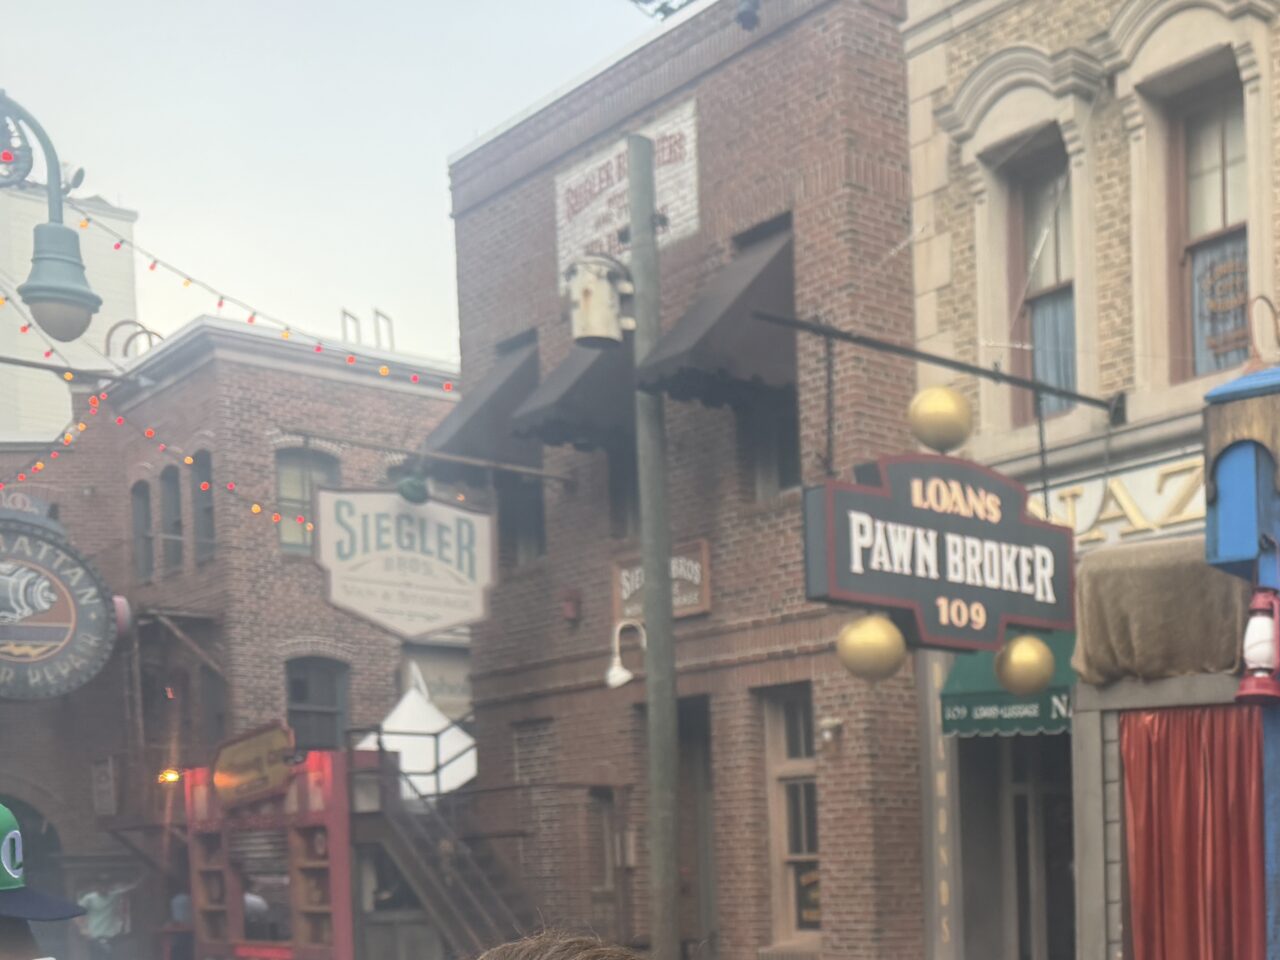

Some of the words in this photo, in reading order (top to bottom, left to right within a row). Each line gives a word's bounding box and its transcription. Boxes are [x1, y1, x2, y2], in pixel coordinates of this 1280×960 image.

[911, 477, 1002, 524] LOANS
[334, 499, 477, 583] SIEGLER
[848, 509, 940, 580] PAWN
[945, 532, 1057, 604] BROKER
[936, 596, 987, 631] 109
[1051, 693, 1073, 719] N
